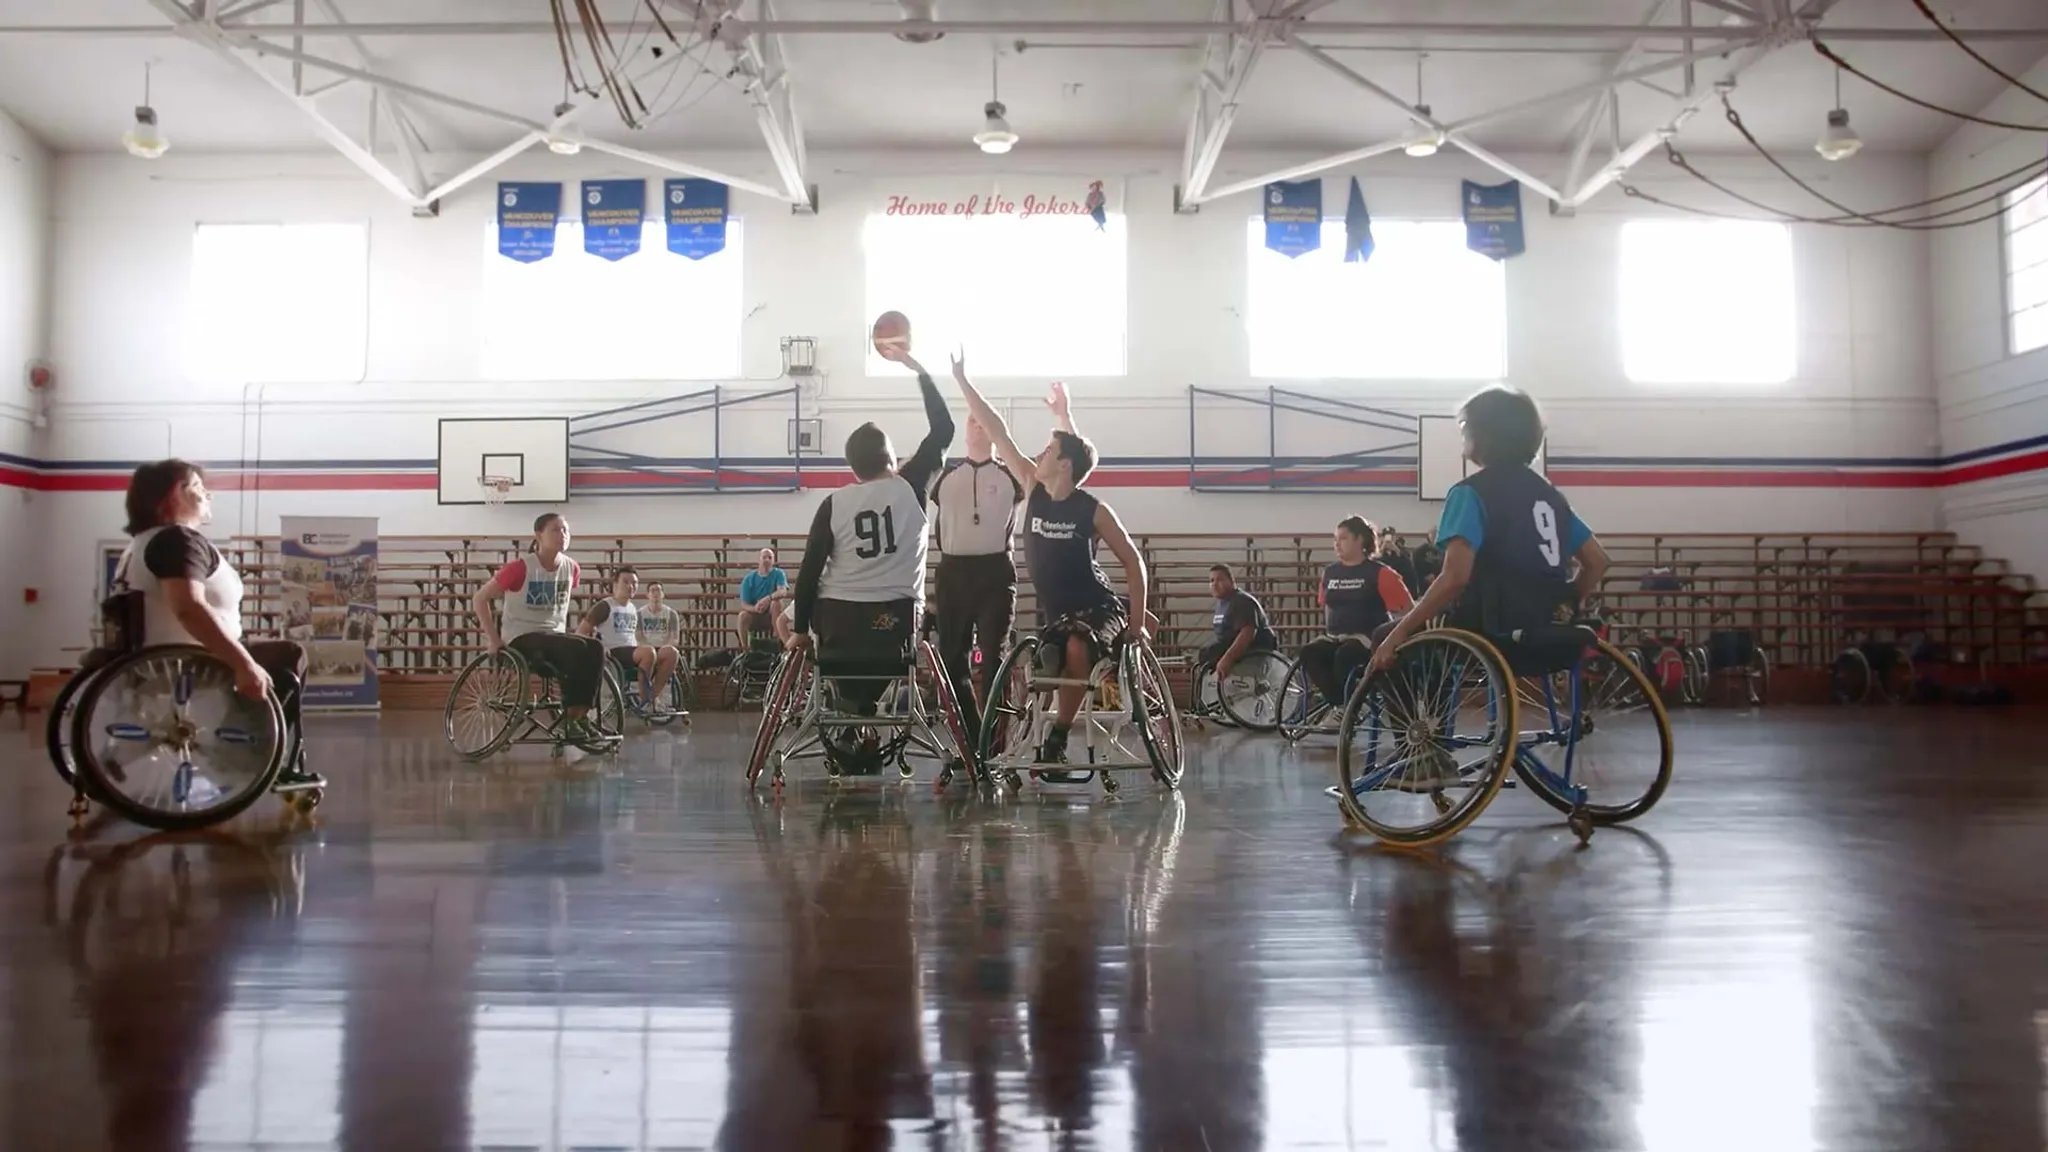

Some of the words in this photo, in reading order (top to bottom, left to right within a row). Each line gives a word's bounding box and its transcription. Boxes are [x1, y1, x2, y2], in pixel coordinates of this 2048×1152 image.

[671, 208, 723, 216] VANCOUVER
[886, 195, 947, 216] Home
[954, 194, 978, 220] of
[981, 194, 1015, 215] the
[1020, 194, 1093, 219] Jokers
[503, 212, 554, 220] VANCOUVER
[587, 210, 640, 218] VANCOUVER
[854, 504, 898, 560] 91
[1532, 500, 1560, 567] 9
[302, 533, 318, 545] BC
